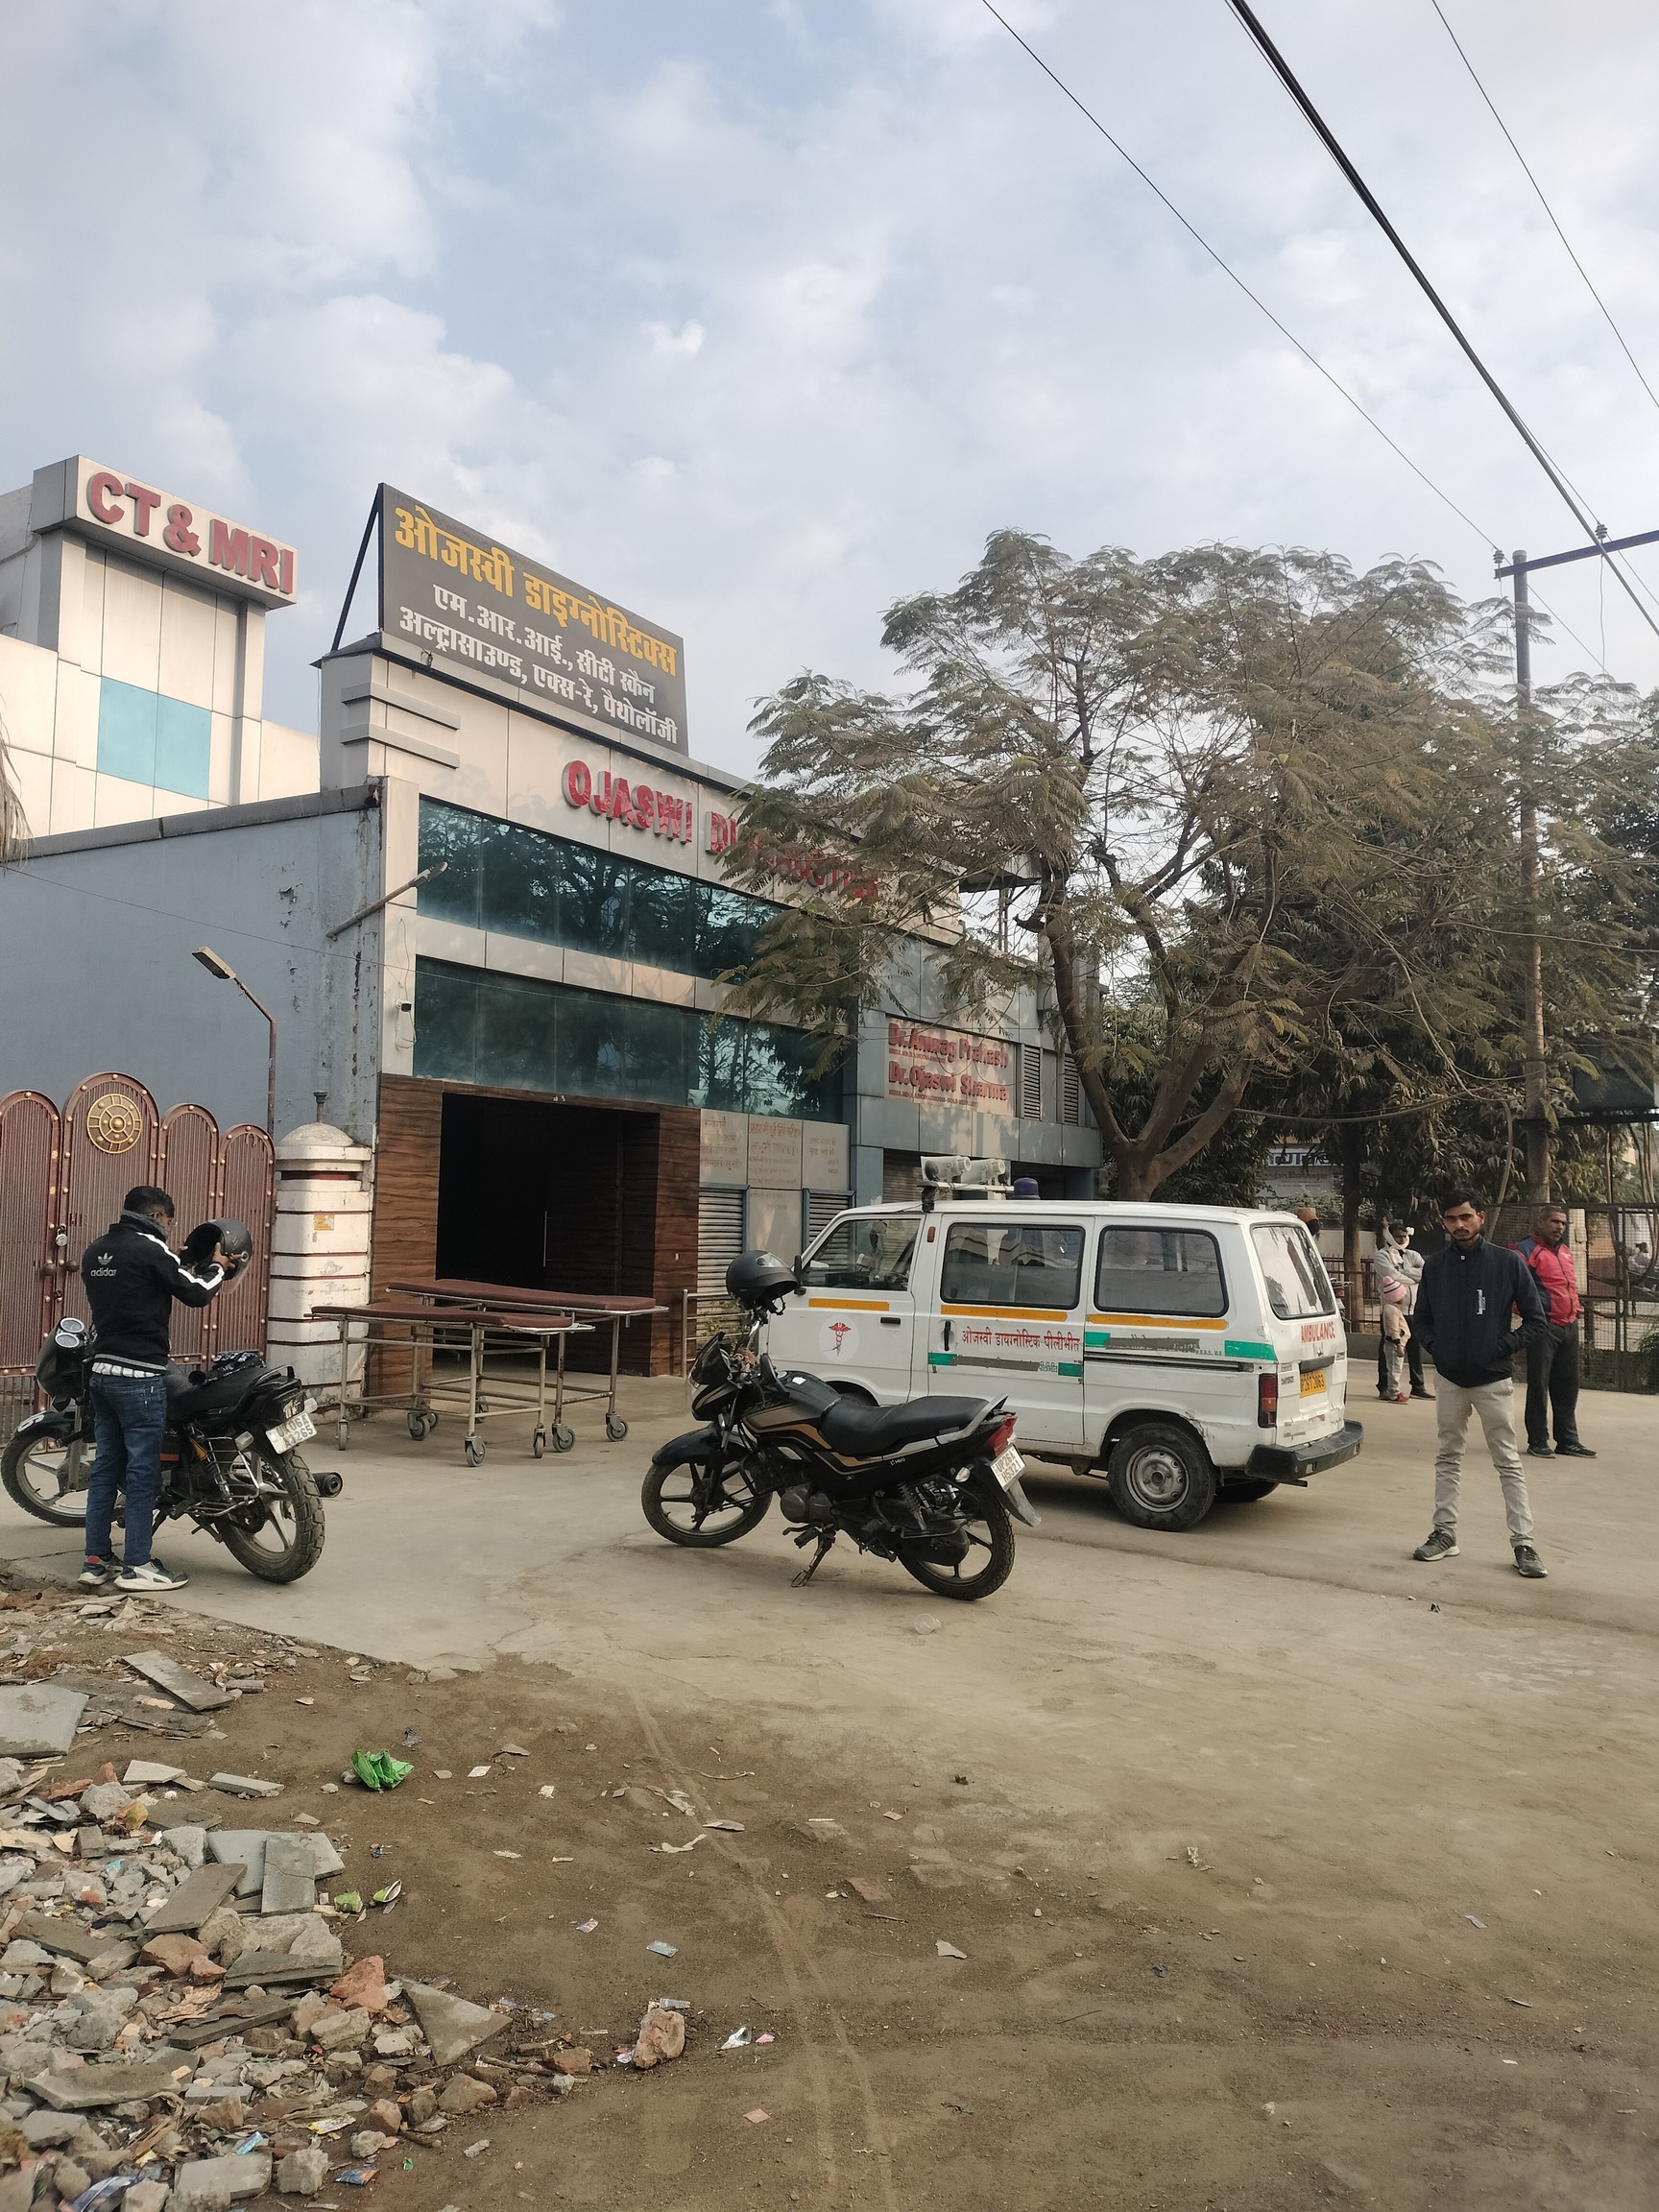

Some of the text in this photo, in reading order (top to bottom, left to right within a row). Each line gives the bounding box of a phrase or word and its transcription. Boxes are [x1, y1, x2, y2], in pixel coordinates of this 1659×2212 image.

[86, 471, 294, 595] CT & MRI
[395, 504, 677, 677] ओजस्वी डाइग्नोस्टिक्स
[619, 667, 656, 704] स्कैन
[602, 686, 678, 745] पैथोलॉजी
[562, 759, 692, 845] OJASWI
[960, 1074, 1007, 1100] Sharma
[90, 1267, 117, 1277] adidas
[962, 1326, 992, 1346] ओजस्वी
[1300, 1321, 1336, 1343] AMBULANCE
[995, 1450, 1017, 1473] UP26A
